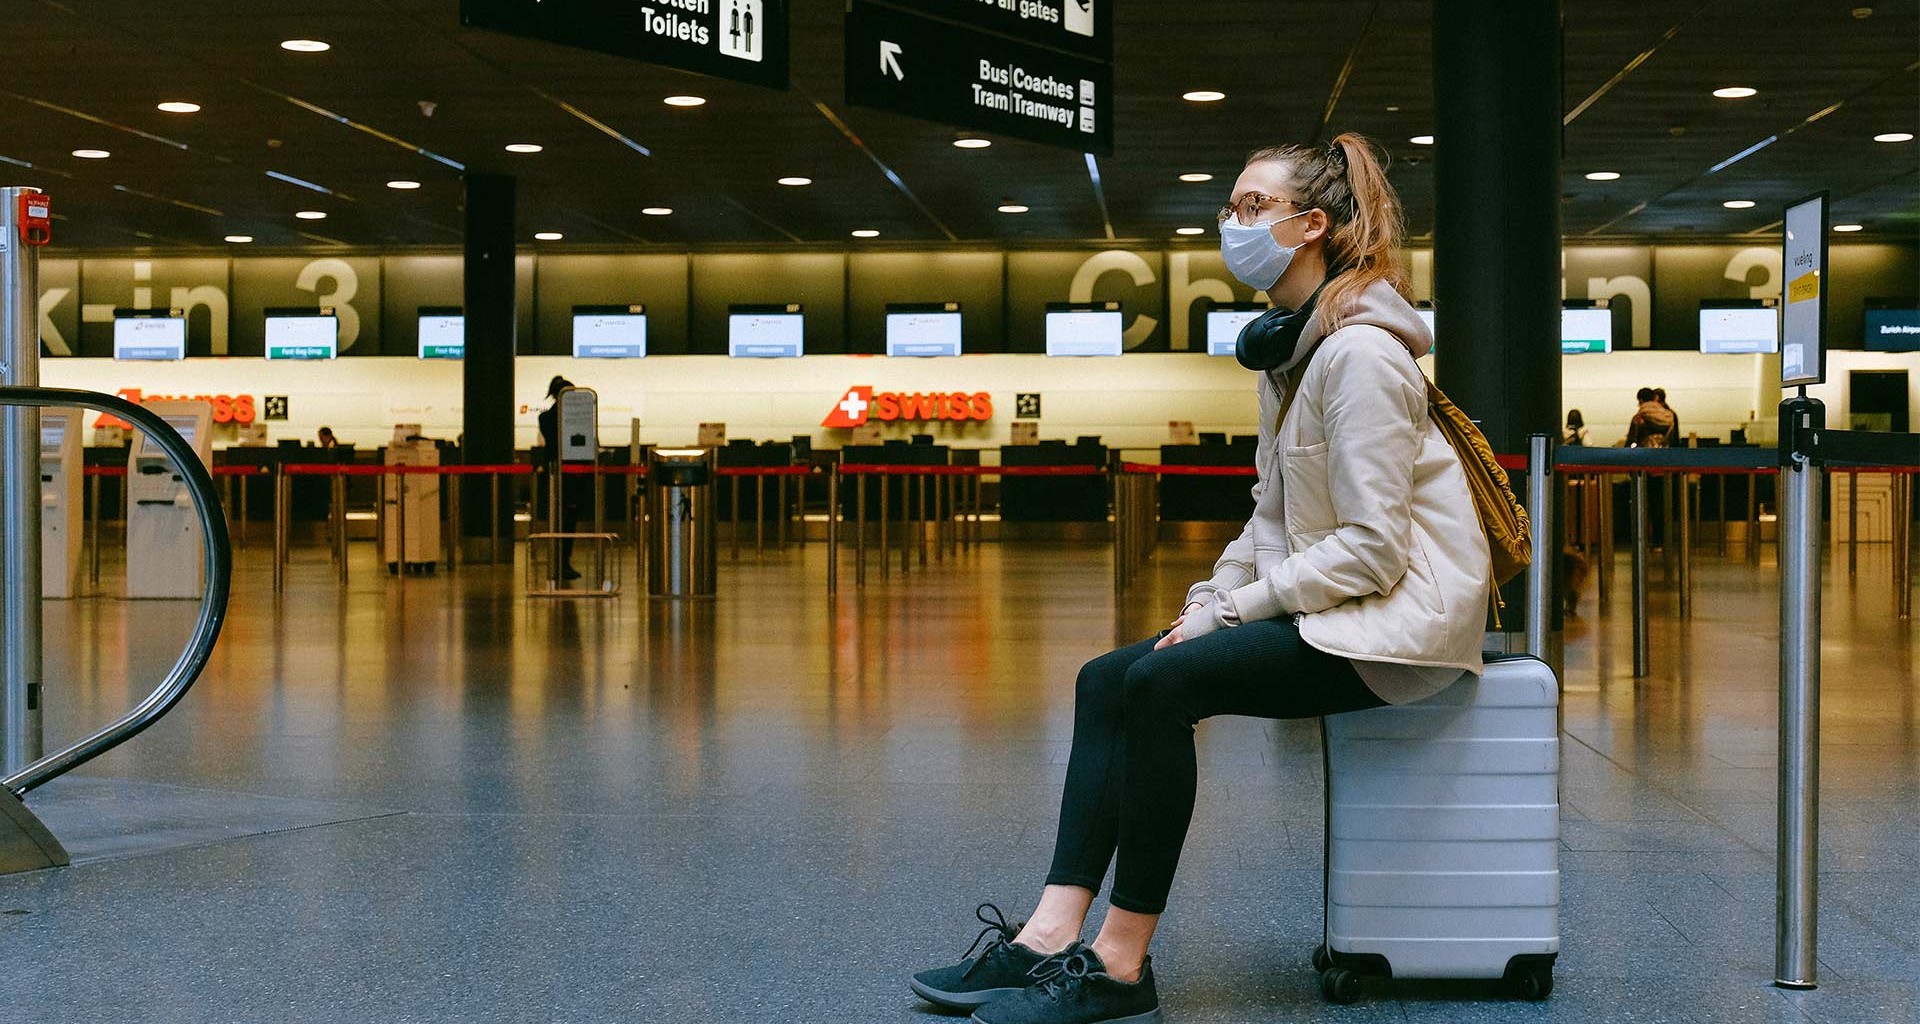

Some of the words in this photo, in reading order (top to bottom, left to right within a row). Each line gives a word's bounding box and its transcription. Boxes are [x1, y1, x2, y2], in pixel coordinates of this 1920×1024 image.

[641, 7, 709, 45] Toilets
[1020, 0, 1059, 23] gates
[1794, 250, 1813, 268] vueling
[296, 258, 360, 353] 3
[876, 392, 993, 421] SWISS
